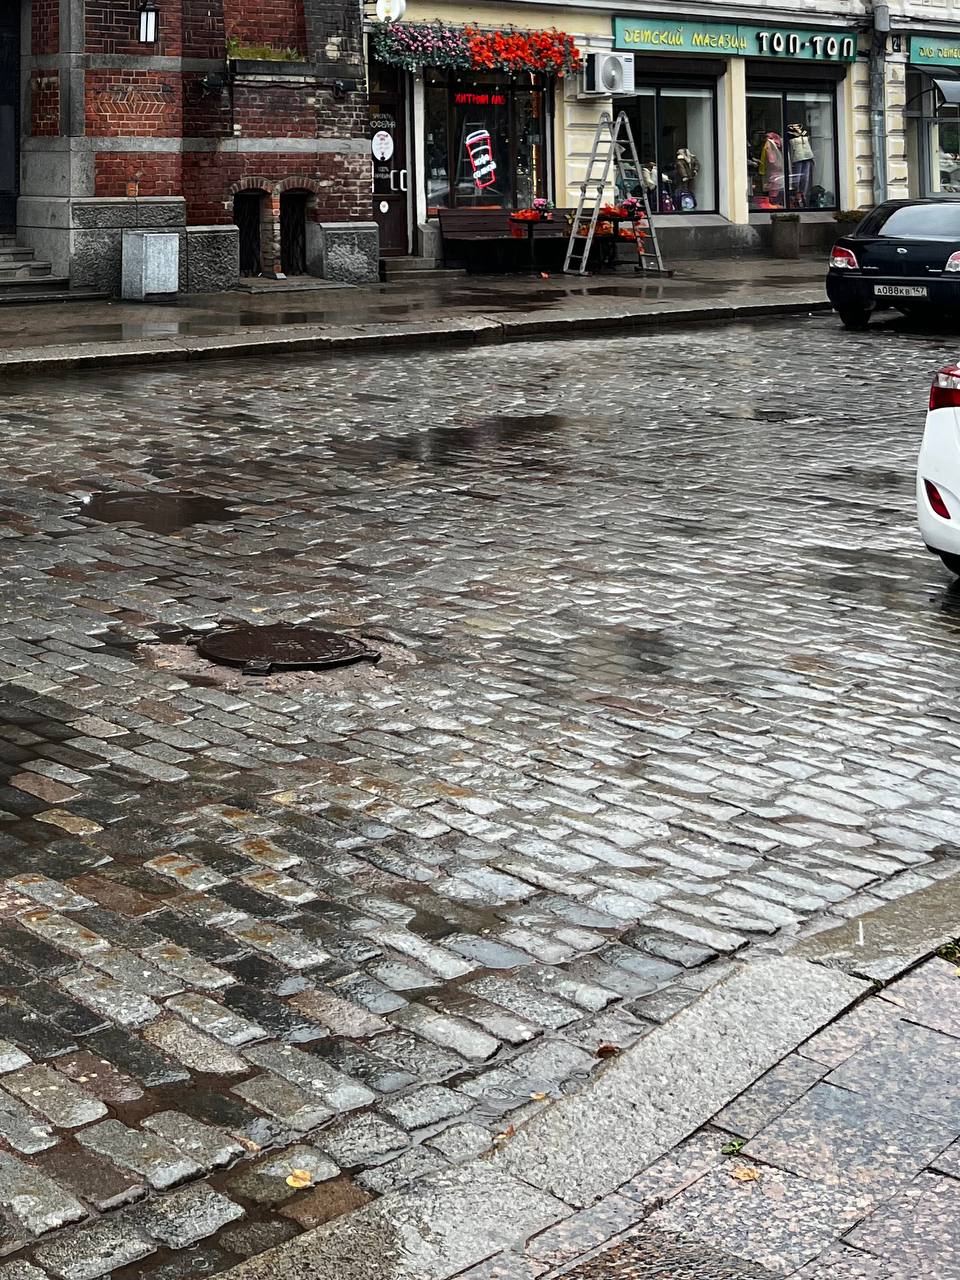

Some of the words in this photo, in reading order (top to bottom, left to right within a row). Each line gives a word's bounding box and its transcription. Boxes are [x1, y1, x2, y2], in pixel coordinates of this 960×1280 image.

[624, 26, 684, 46] ДЕТСКИЙ
[692, 31, 747, 49] МАГАЗИН
[758, 32, 854, 57] ТОП-ТОП
